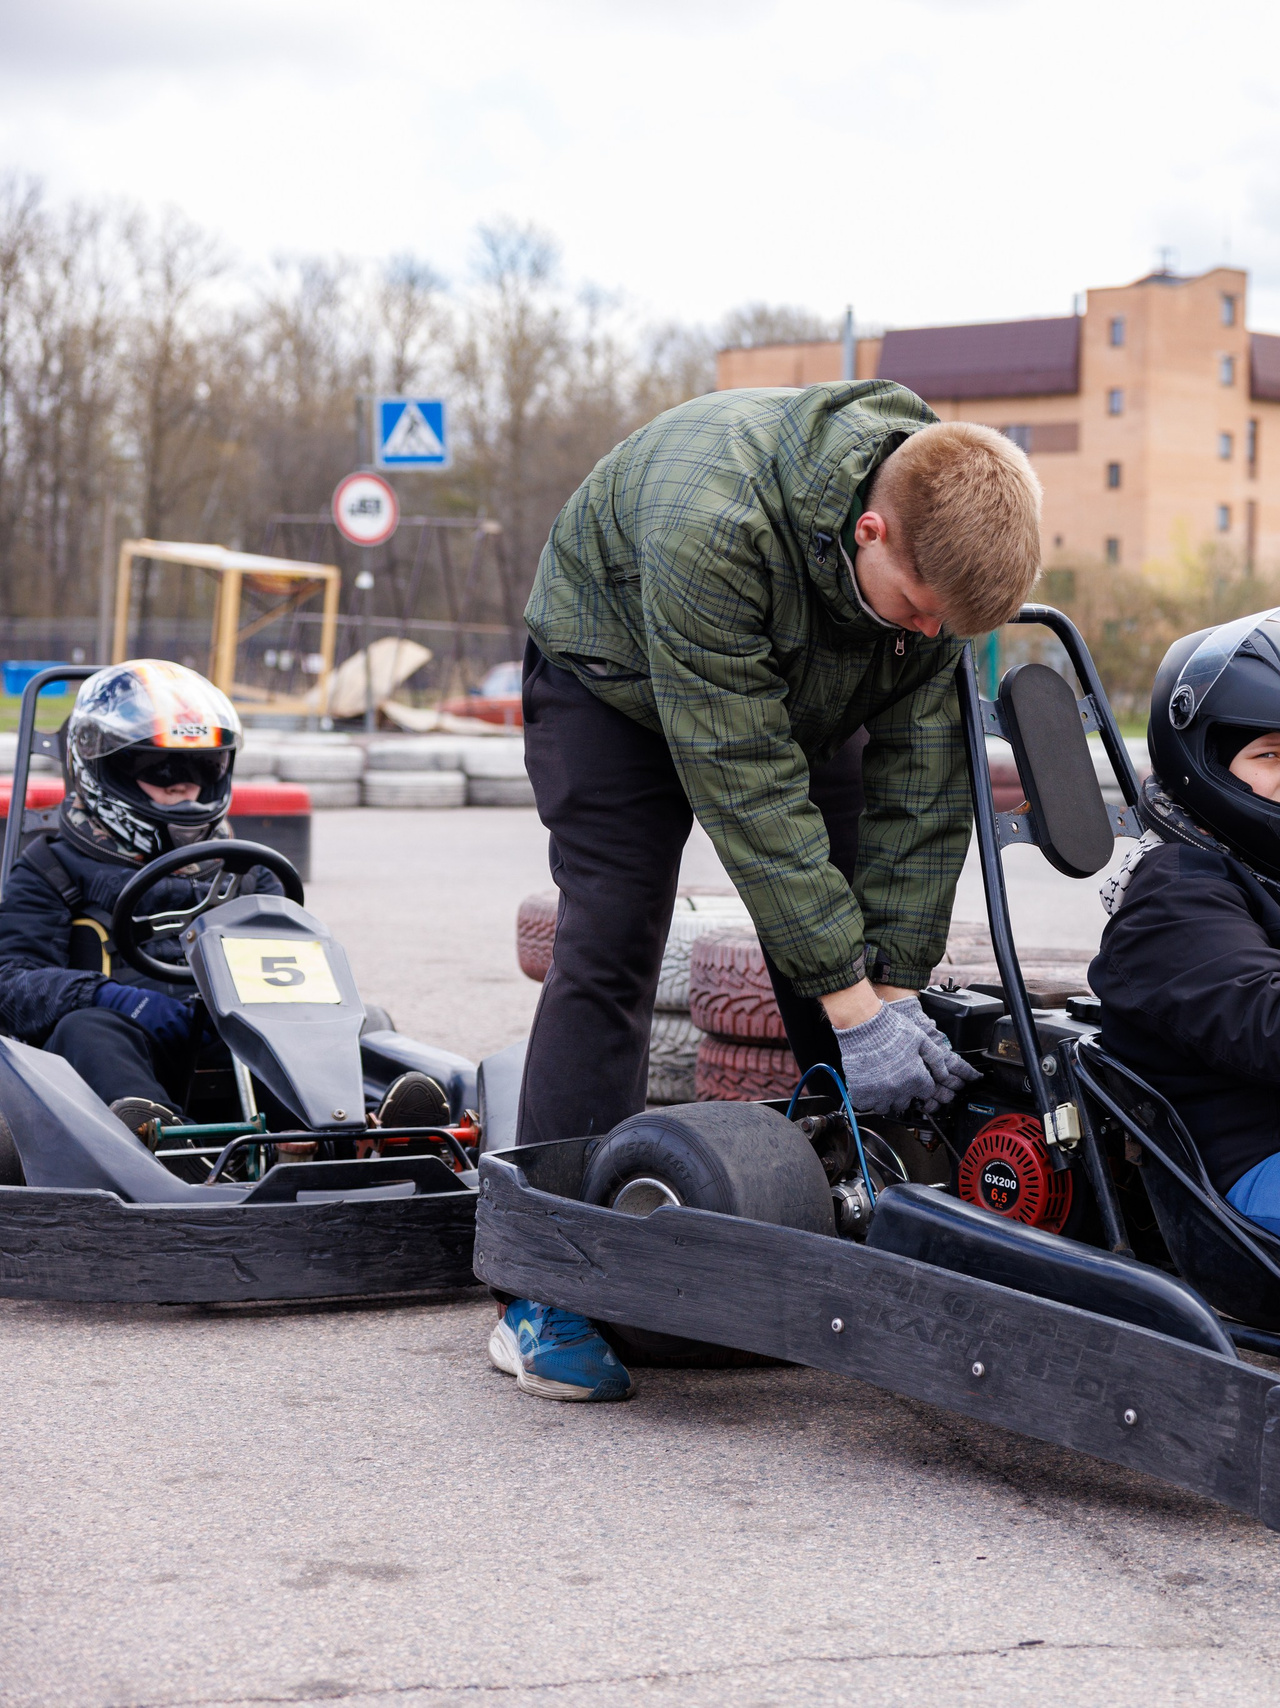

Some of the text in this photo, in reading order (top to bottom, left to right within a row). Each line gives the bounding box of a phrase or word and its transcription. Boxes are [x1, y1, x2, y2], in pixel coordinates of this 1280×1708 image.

[260, 955, 306, 987] 5
[984, 1173, 1017, 1190] GX200
[991, 1187, 1008, 1203] 6.5
